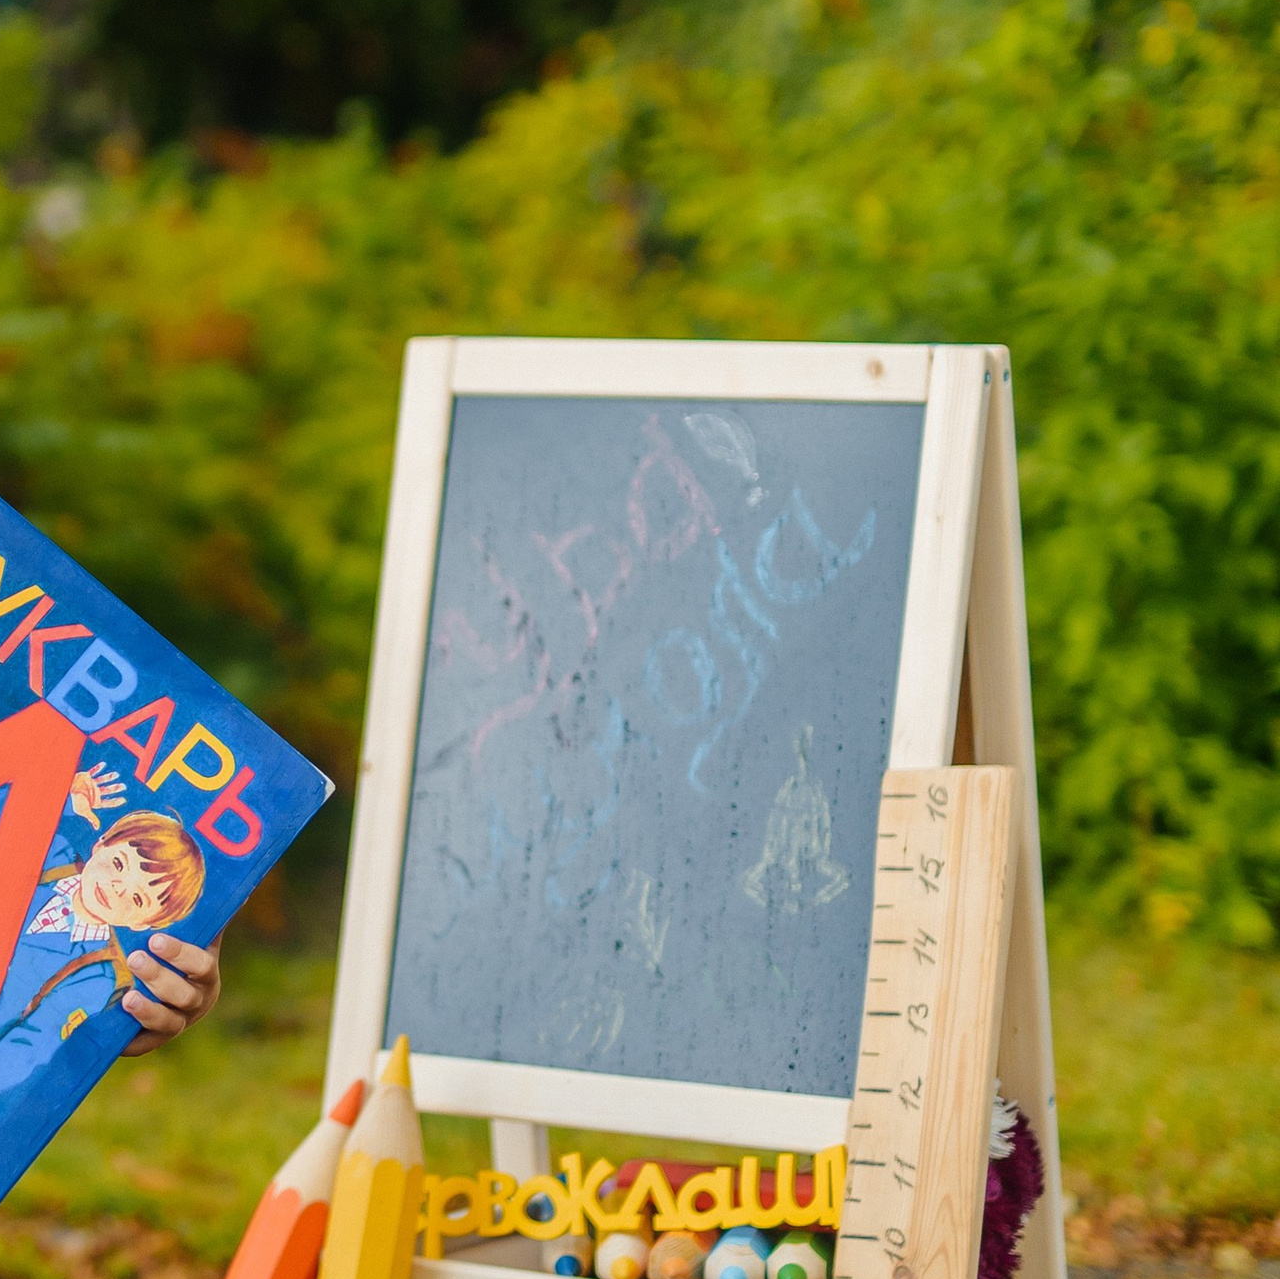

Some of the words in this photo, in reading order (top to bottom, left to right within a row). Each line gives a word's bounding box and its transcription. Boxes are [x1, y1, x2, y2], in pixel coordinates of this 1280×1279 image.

[925, 784, 949, 822] 16
[919, 854, 946, 894] 15
[912, 928, 938, 965] 14
[907, 1002, 929, 1035] 13
[898, 1076, 922, 1110] 12
[893, 1155, 917, 1190] 11
[883, 1227, 906, 1264] 10
